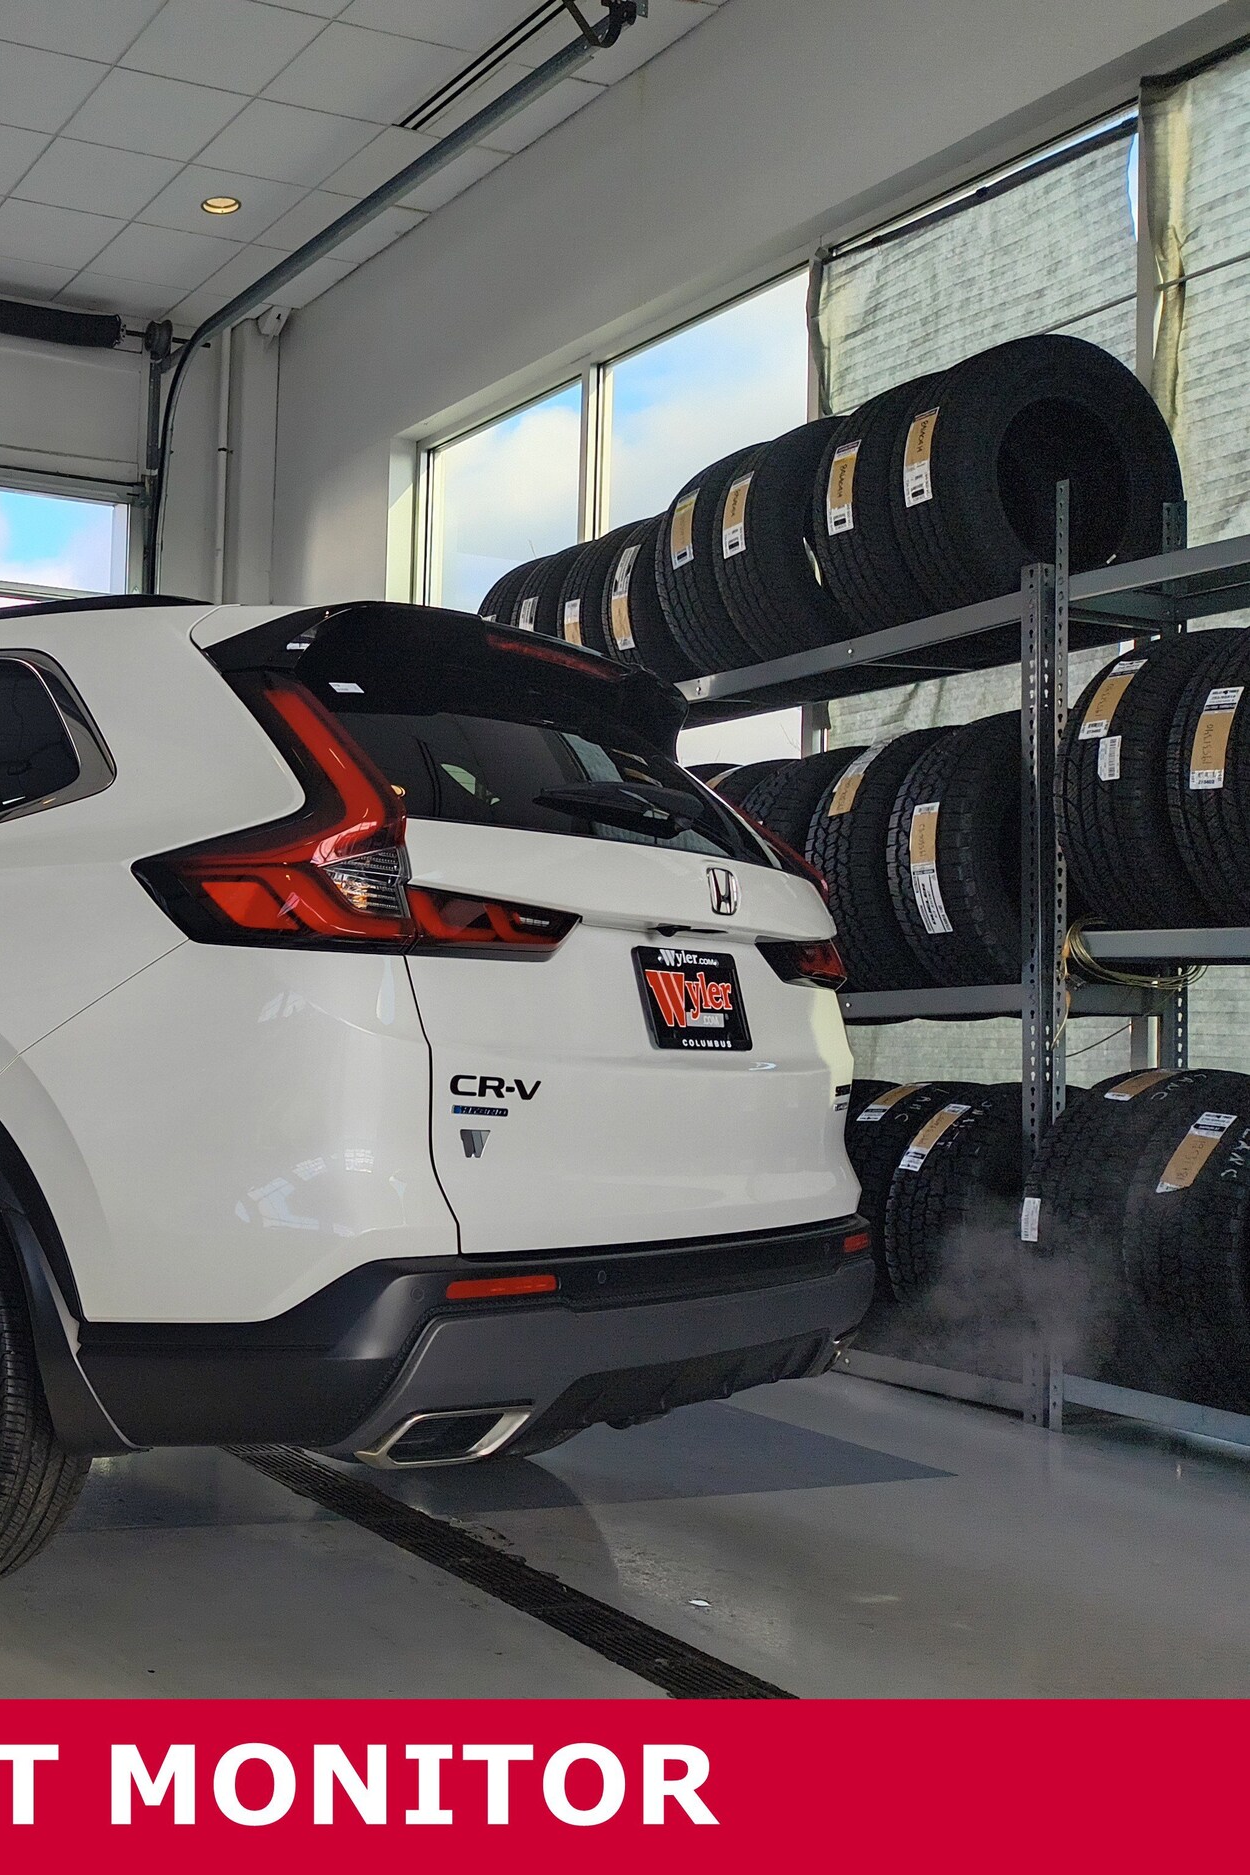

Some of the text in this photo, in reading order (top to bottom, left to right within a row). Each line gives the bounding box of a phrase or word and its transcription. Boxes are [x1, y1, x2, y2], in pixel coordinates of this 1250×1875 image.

[645, 969, 733, 1028] Wyler
[682, 1039, 732, 1048] COLUMBUS
[450, 1075, 542, 1100] CR-V
